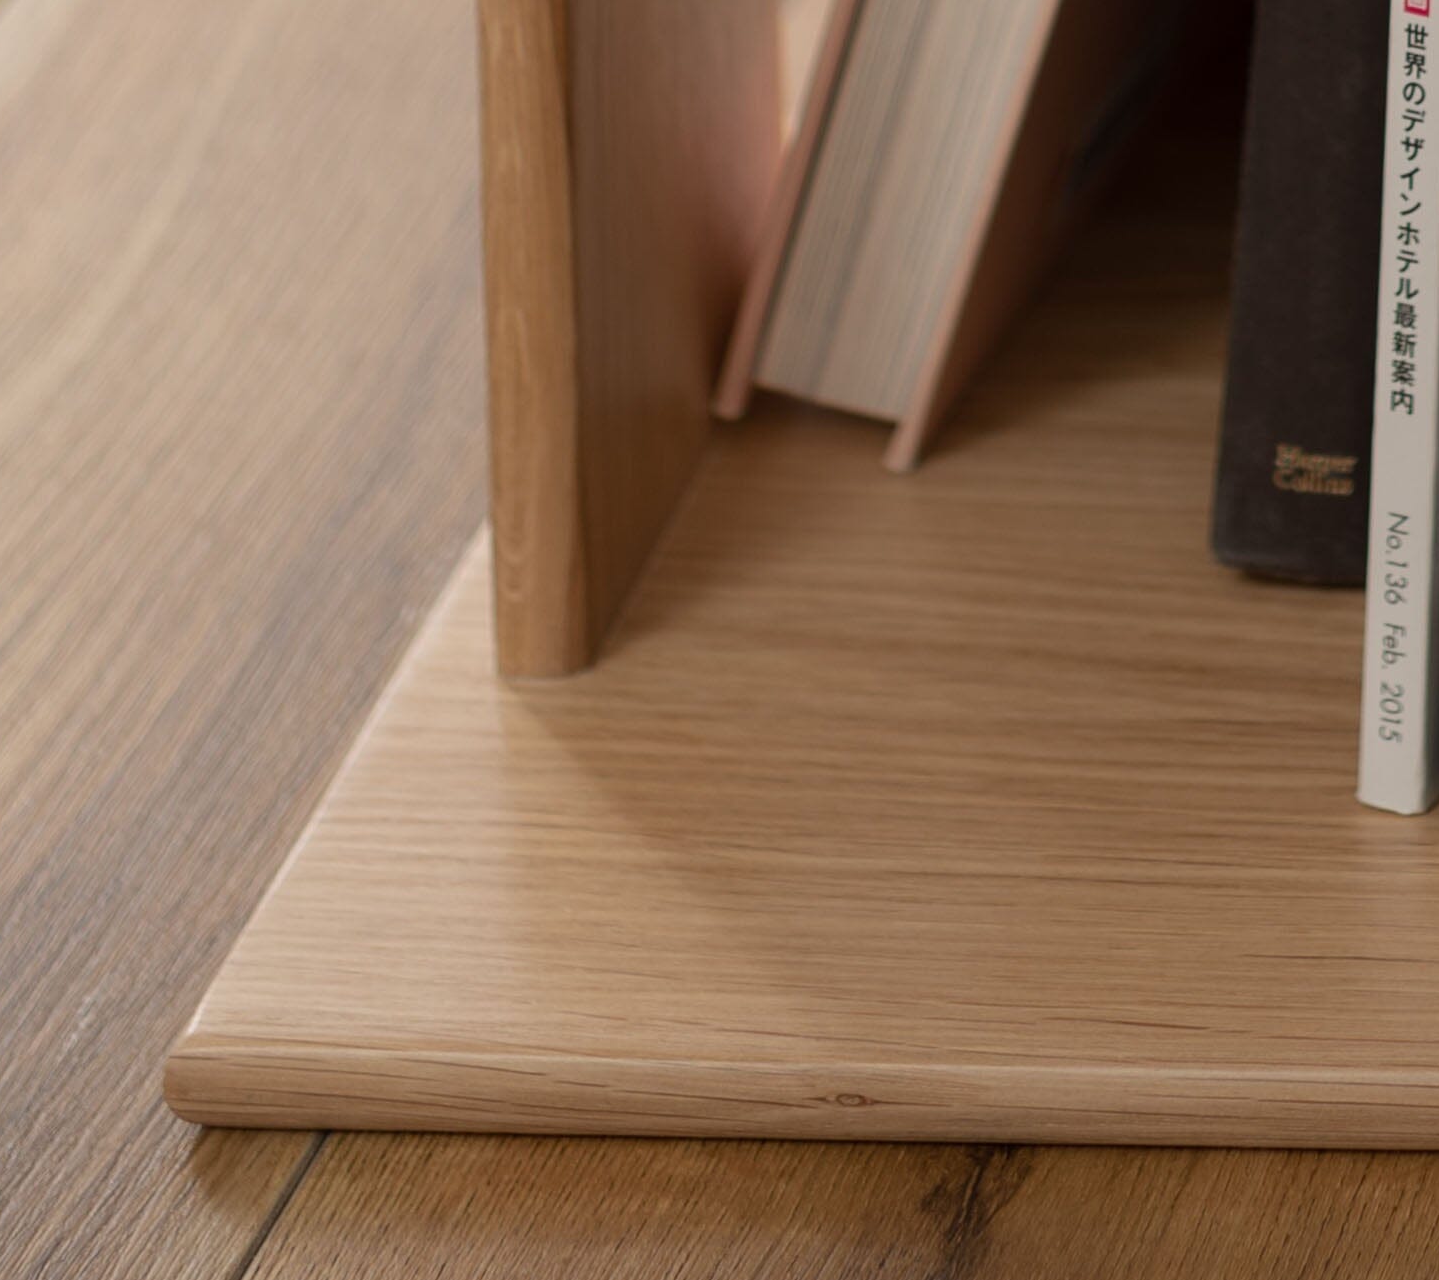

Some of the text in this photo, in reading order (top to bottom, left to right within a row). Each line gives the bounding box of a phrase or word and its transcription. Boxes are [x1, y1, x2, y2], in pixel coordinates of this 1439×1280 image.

[1378, 511, 1410, 743] No.136 Feb. 2015
